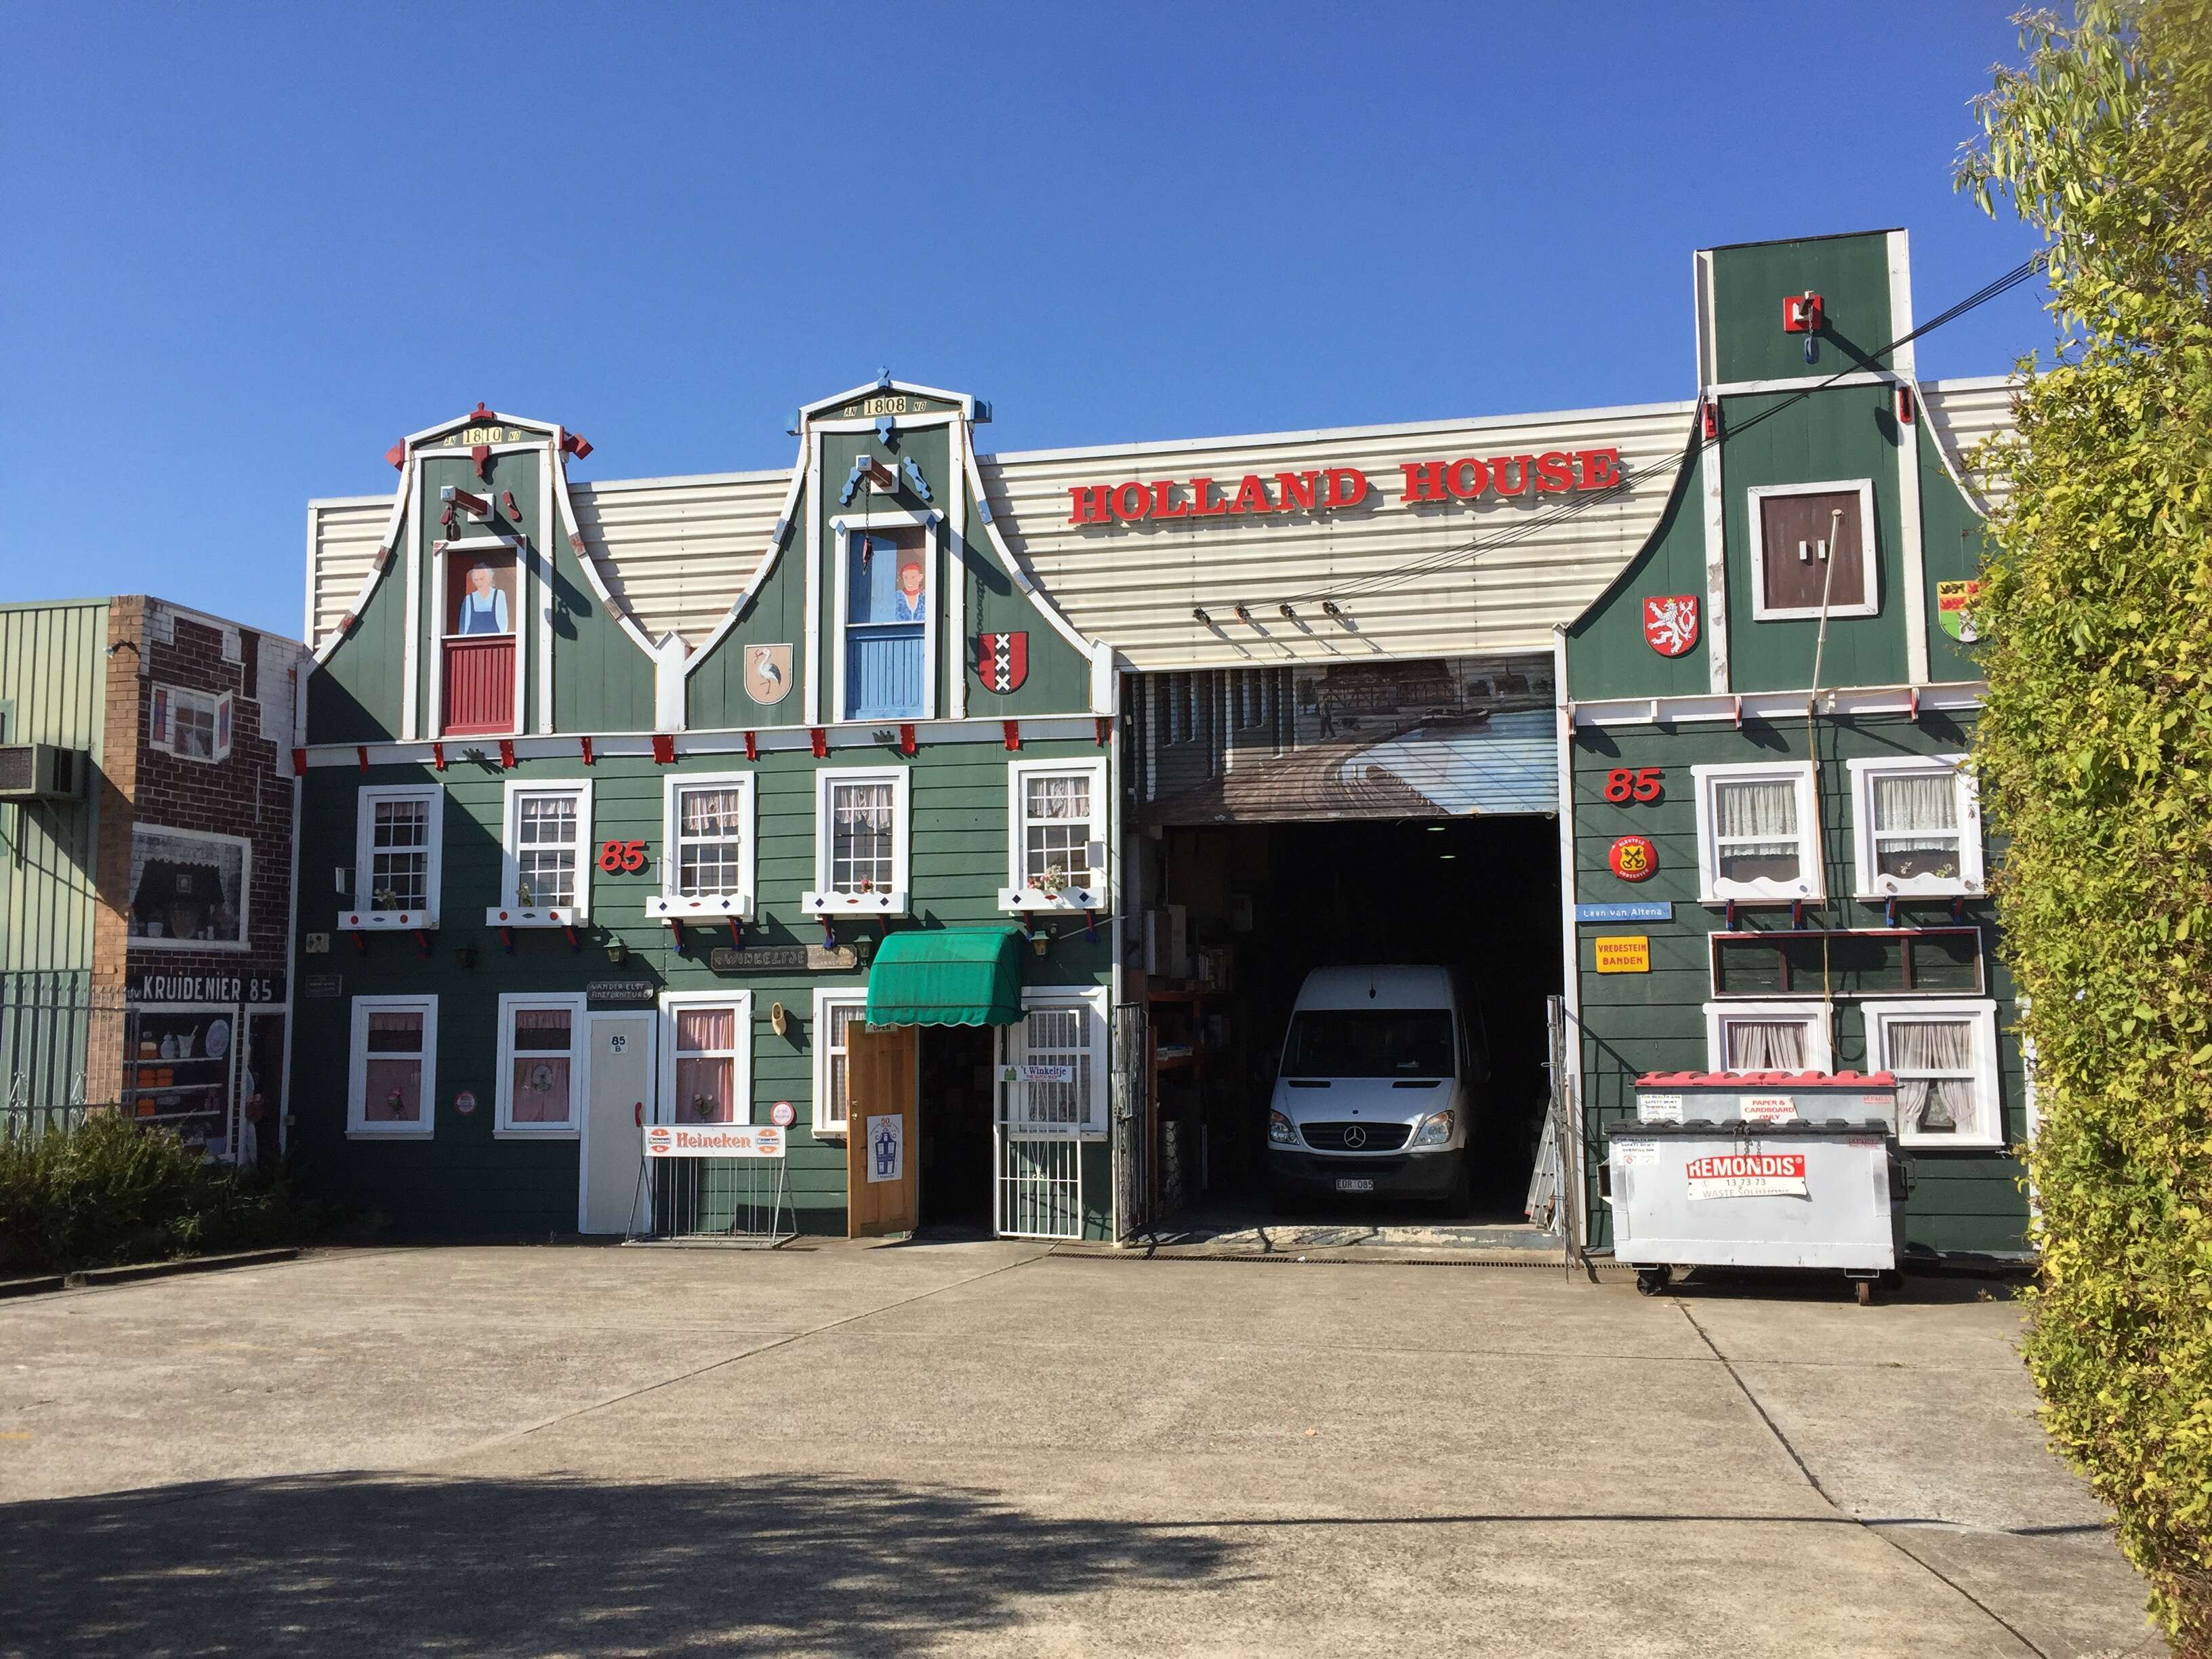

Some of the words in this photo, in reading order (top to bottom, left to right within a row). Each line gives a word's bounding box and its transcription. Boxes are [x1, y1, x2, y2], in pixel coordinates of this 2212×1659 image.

[867, 397, 905, 414] 1808
[466, 428, 501, 443] 1810
[1068, 467, 1368, 525] HOLLAND
[1399, 448, 1620, 501] HOUSE
[1604, 768, 1660, 802] 85
[599, 840, 645, 871] 85
[1631, 908, 1662, 916] Altena
[1599, 944, 1647, 953] VREDESTEIN
[1603, 957, 1643, 965] BANDEN
[143, 972, 241, 1001] KRUIDENIER
[249, 979, 272, 1001] 85
[611, 1036, 626, 1045] 85
[1030, 1066, 1067, 1078] Winkeltje
[676, 1132, 751, 1148] Heineken
[1702, 1189, 1736, 1198] WASTE
